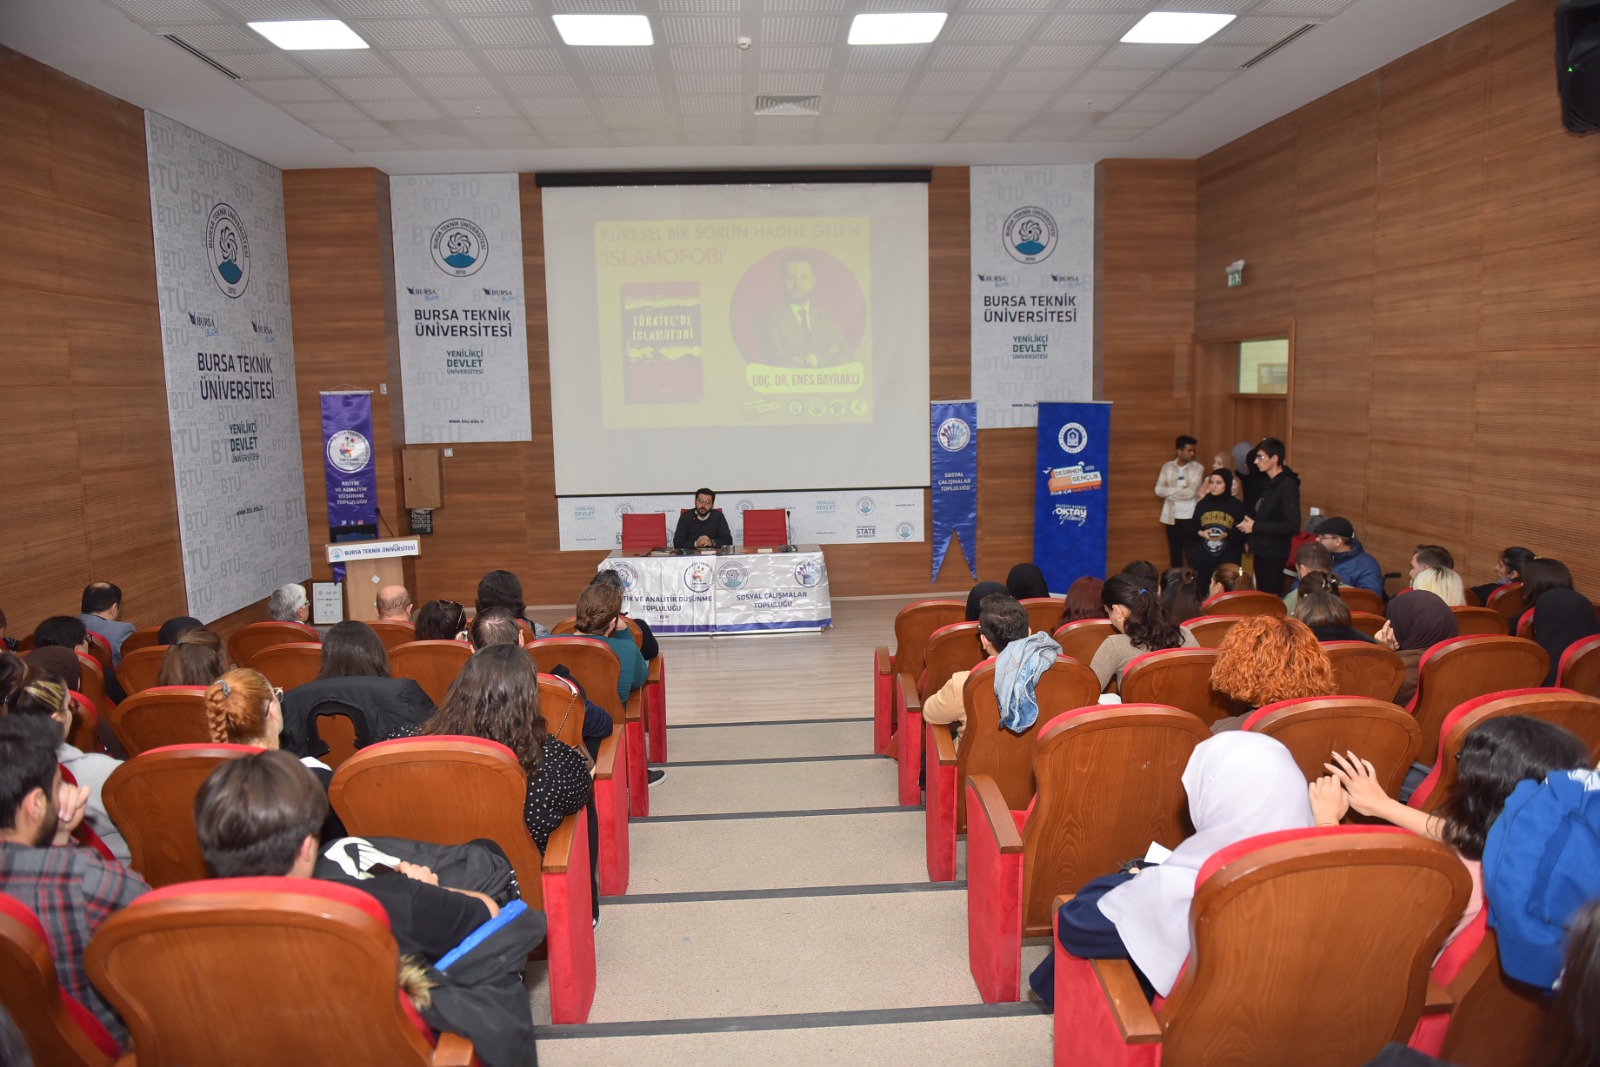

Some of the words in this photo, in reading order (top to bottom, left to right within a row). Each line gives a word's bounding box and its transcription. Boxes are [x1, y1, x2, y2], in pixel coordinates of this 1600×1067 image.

[601, 225, 663, 242] KÜRESEL
[668, 223, 689, 241] BİR
[695, 224, 748, 241] SORUN
[812, 224, 860, 239] GELEN
[415, 288, 437, 296] BURSA
[491, 288, 513, 296] BURSA
[983, 295, 1026, 307] BURSA
[1030, 292, 1077, 307] TEKNİK
[414, 309, 459, 321] BURSA
[462, 306, 511, 321] TEKNİK
[633, 313, 692, 327] TÜRKİYE'DE
[984, 307, 1077, 323] ÜNİVERSİTESİ
[415, 322, 512, 337] ÜNİVERSİTESİ
[632, 327, 694, 341] İSLAMOFOBİ
[1013, 334, 1048, 343] YENİLİKÇİ
[446, 349, 483, 358] YENİLİKÇİ
[1013, 344, 1048, 353] DEVLET
[197, 352, 235, 373] BURSA
[237, 352, 273, 374] TEKNİK
[446, 359, 483, 368] DEVLET
[200, 375, 275, 400] ÜNİVERSİTESİ
[752, 375, 772, 388] DOÇ.
[775, 375, 790, 386] DR.
[792, 374, 814, 386] ENES
[817, 373, 860, 386] BAYRAKLI
[230, 420, 257, 435] YENİLİKÇİ
[230, 437, 258, 452] DEVLET
[1072, 472, 1099, 483] GENÇLİK
[1055, 507, 1087, 517] OKTAY
[645, 595, 677, 603] ANALİTİK
[679, 595, 712, 603] DÜŞÜNME
[736, 592, 762, 601] SOSYAL
[764, 591, 808, 600] ÇALIŞMALAR
[753, 600, 792, 608] TOPLULUĞU
